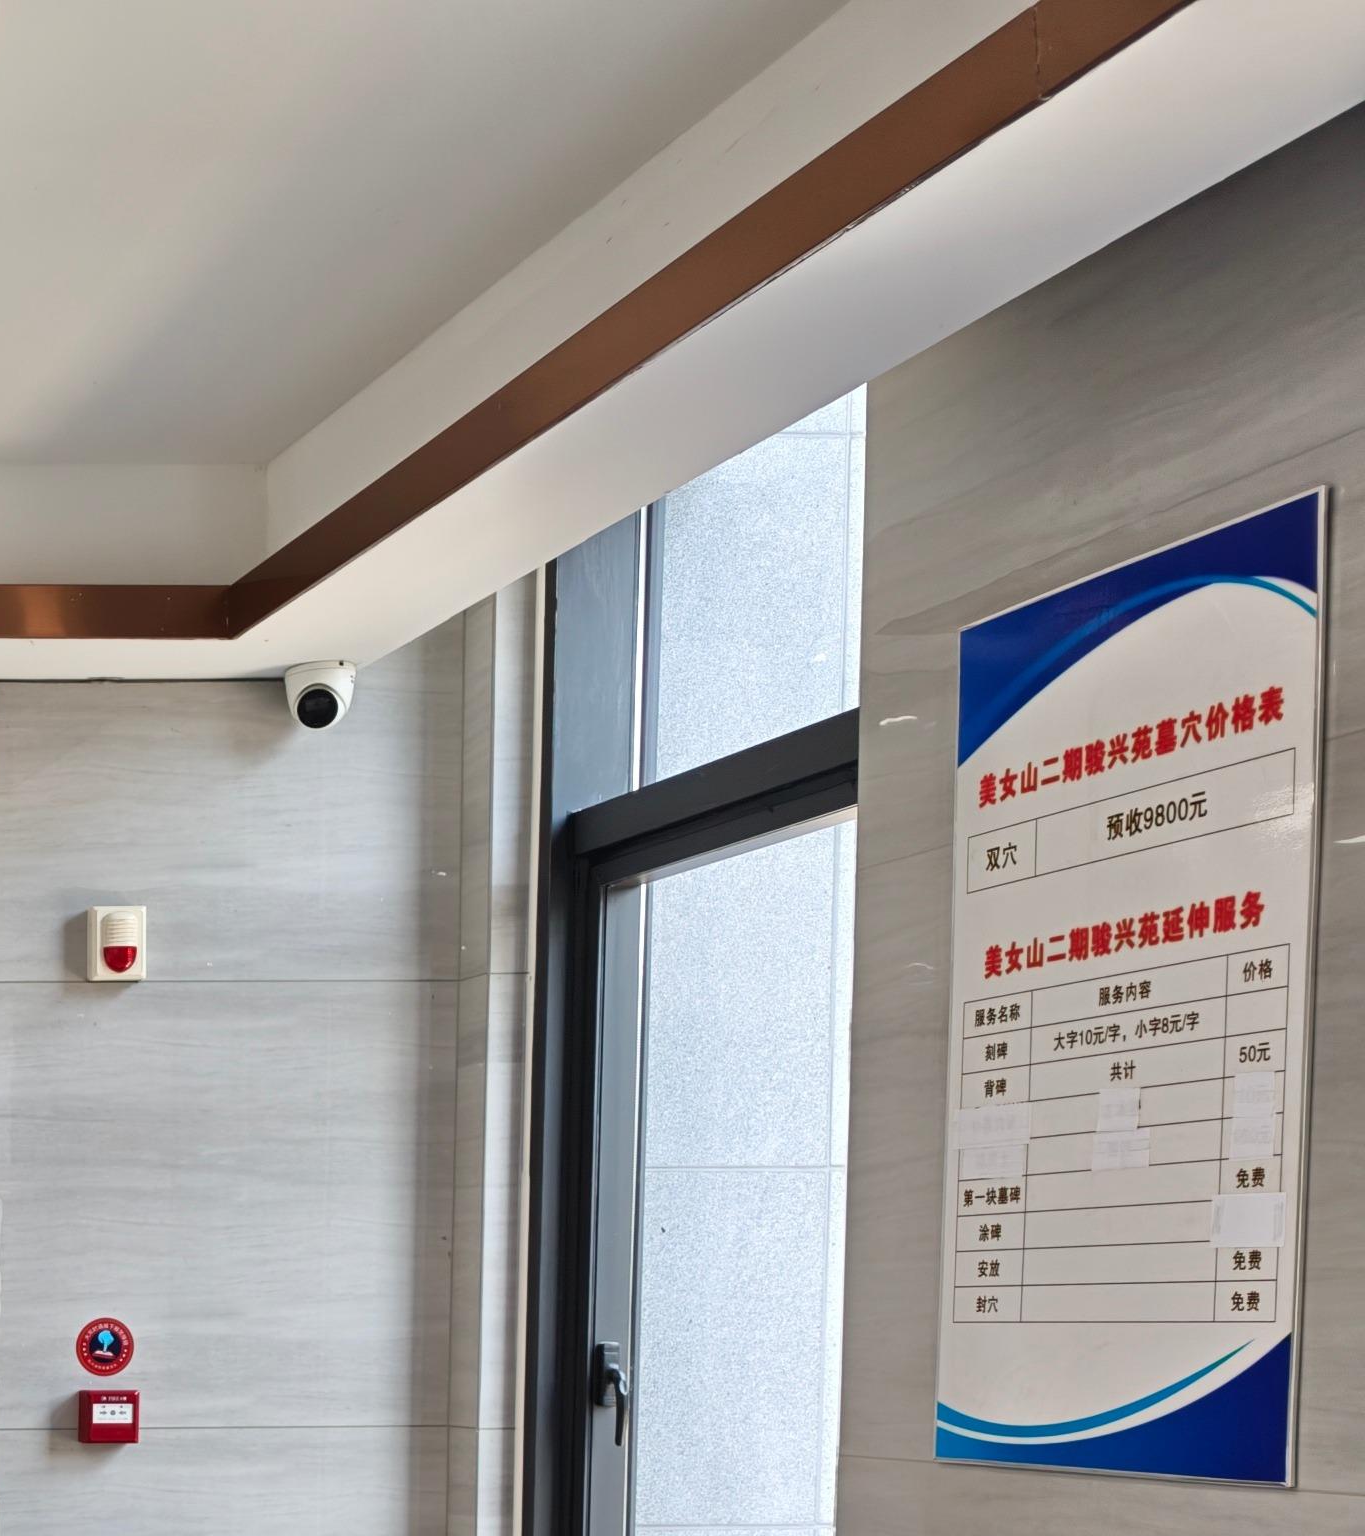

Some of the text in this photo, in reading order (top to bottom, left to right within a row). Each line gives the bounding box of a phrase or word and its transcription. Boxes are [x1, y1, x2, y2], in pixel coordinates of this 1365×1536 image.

[978, 686, 1284, 808] 美女山二期骏兴苑墓穴价格表
[1106, 790, 1208, 841] 预收9800元
[985, 842, 1018, 872] 双穴
[984, 891, 1265, 979] 美女山二期骏兴苑延伸服务
[1242, 958, 1273, 983] 价格
[1098, 980, 1152, 1007] 服务内容
[974, 1003, 1021, 1028] 服务名称
[985, 1041, 1008, 1062] 刻碑
[1238, 1041, 1272, 1065] 50元
[1110, 1060, 1137, 1082] 共计
[983, 1078, 1007, 1099] 背碑
[1236, 1166, 1266, 1189] 免费
[963, 1185, 1022, 1209] 第一块墓碑
[977, 1259, 1001, 1278] 安放
[1232, 1250, 1262, 1272] 免费
[976, 1295, 999, 1315] 封穴
[1230, 1290, 1260, 1313] 免费
